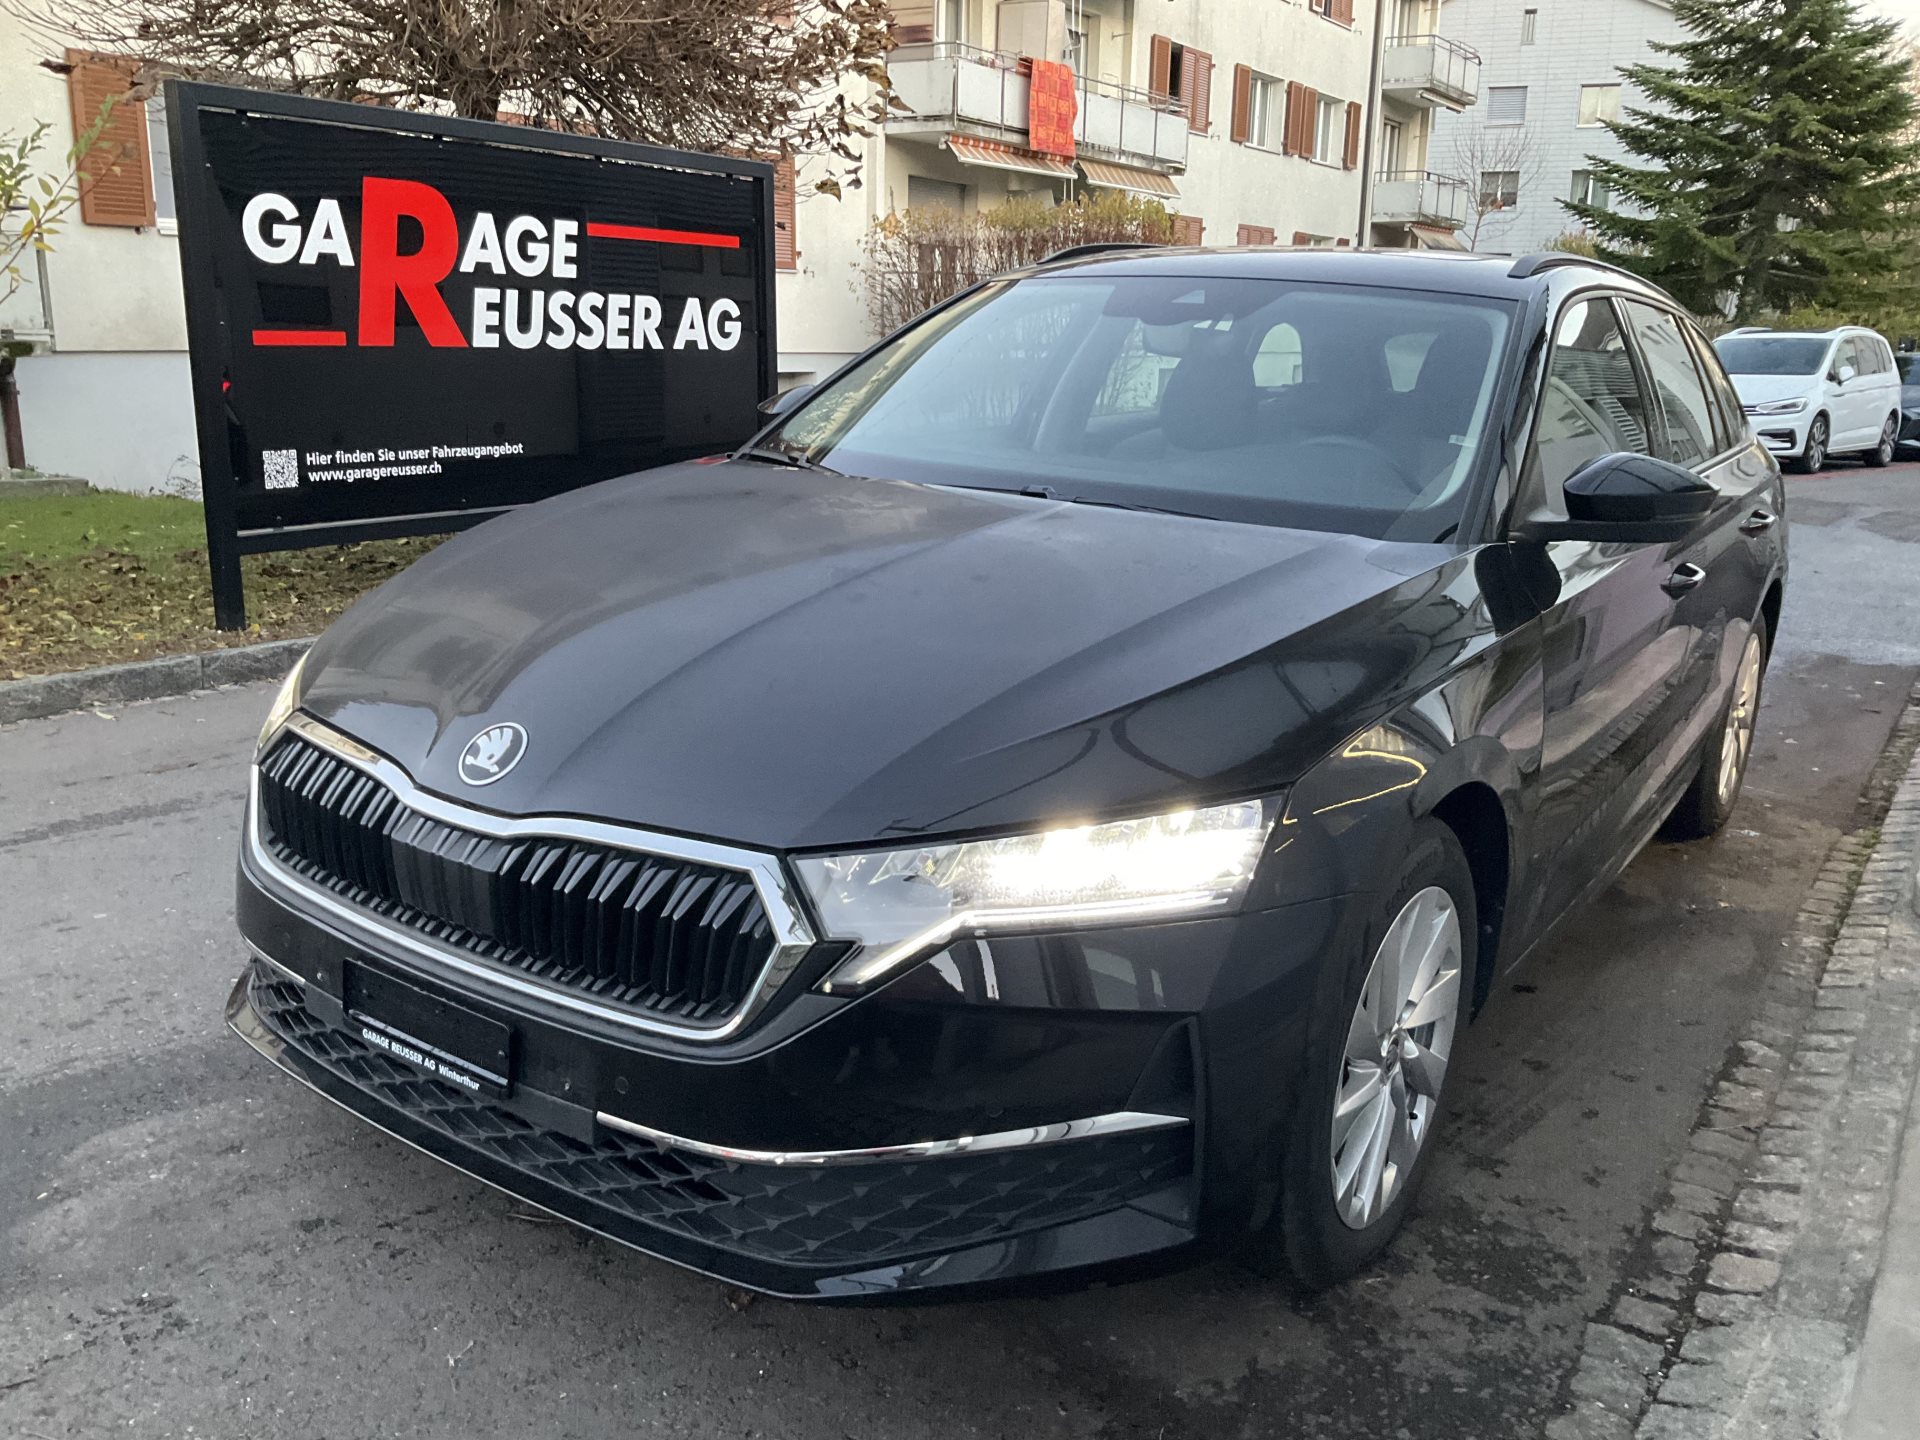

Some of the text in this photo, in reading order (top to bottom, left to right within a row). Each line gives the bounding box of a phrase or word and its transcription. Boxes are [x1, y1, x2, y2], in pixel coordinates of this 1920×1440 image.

[242, 176, 579, 347] GARAGE
[672, 297, 742, 351] AG
[306, 442, 524, 466] Hier finden Sie unser Fahrzeugangebot
[308, 461, 442, 482] www.garagereusser.ch
[362, 1028, 480, 1091] GARAGE REUSSER AG Winterthur
